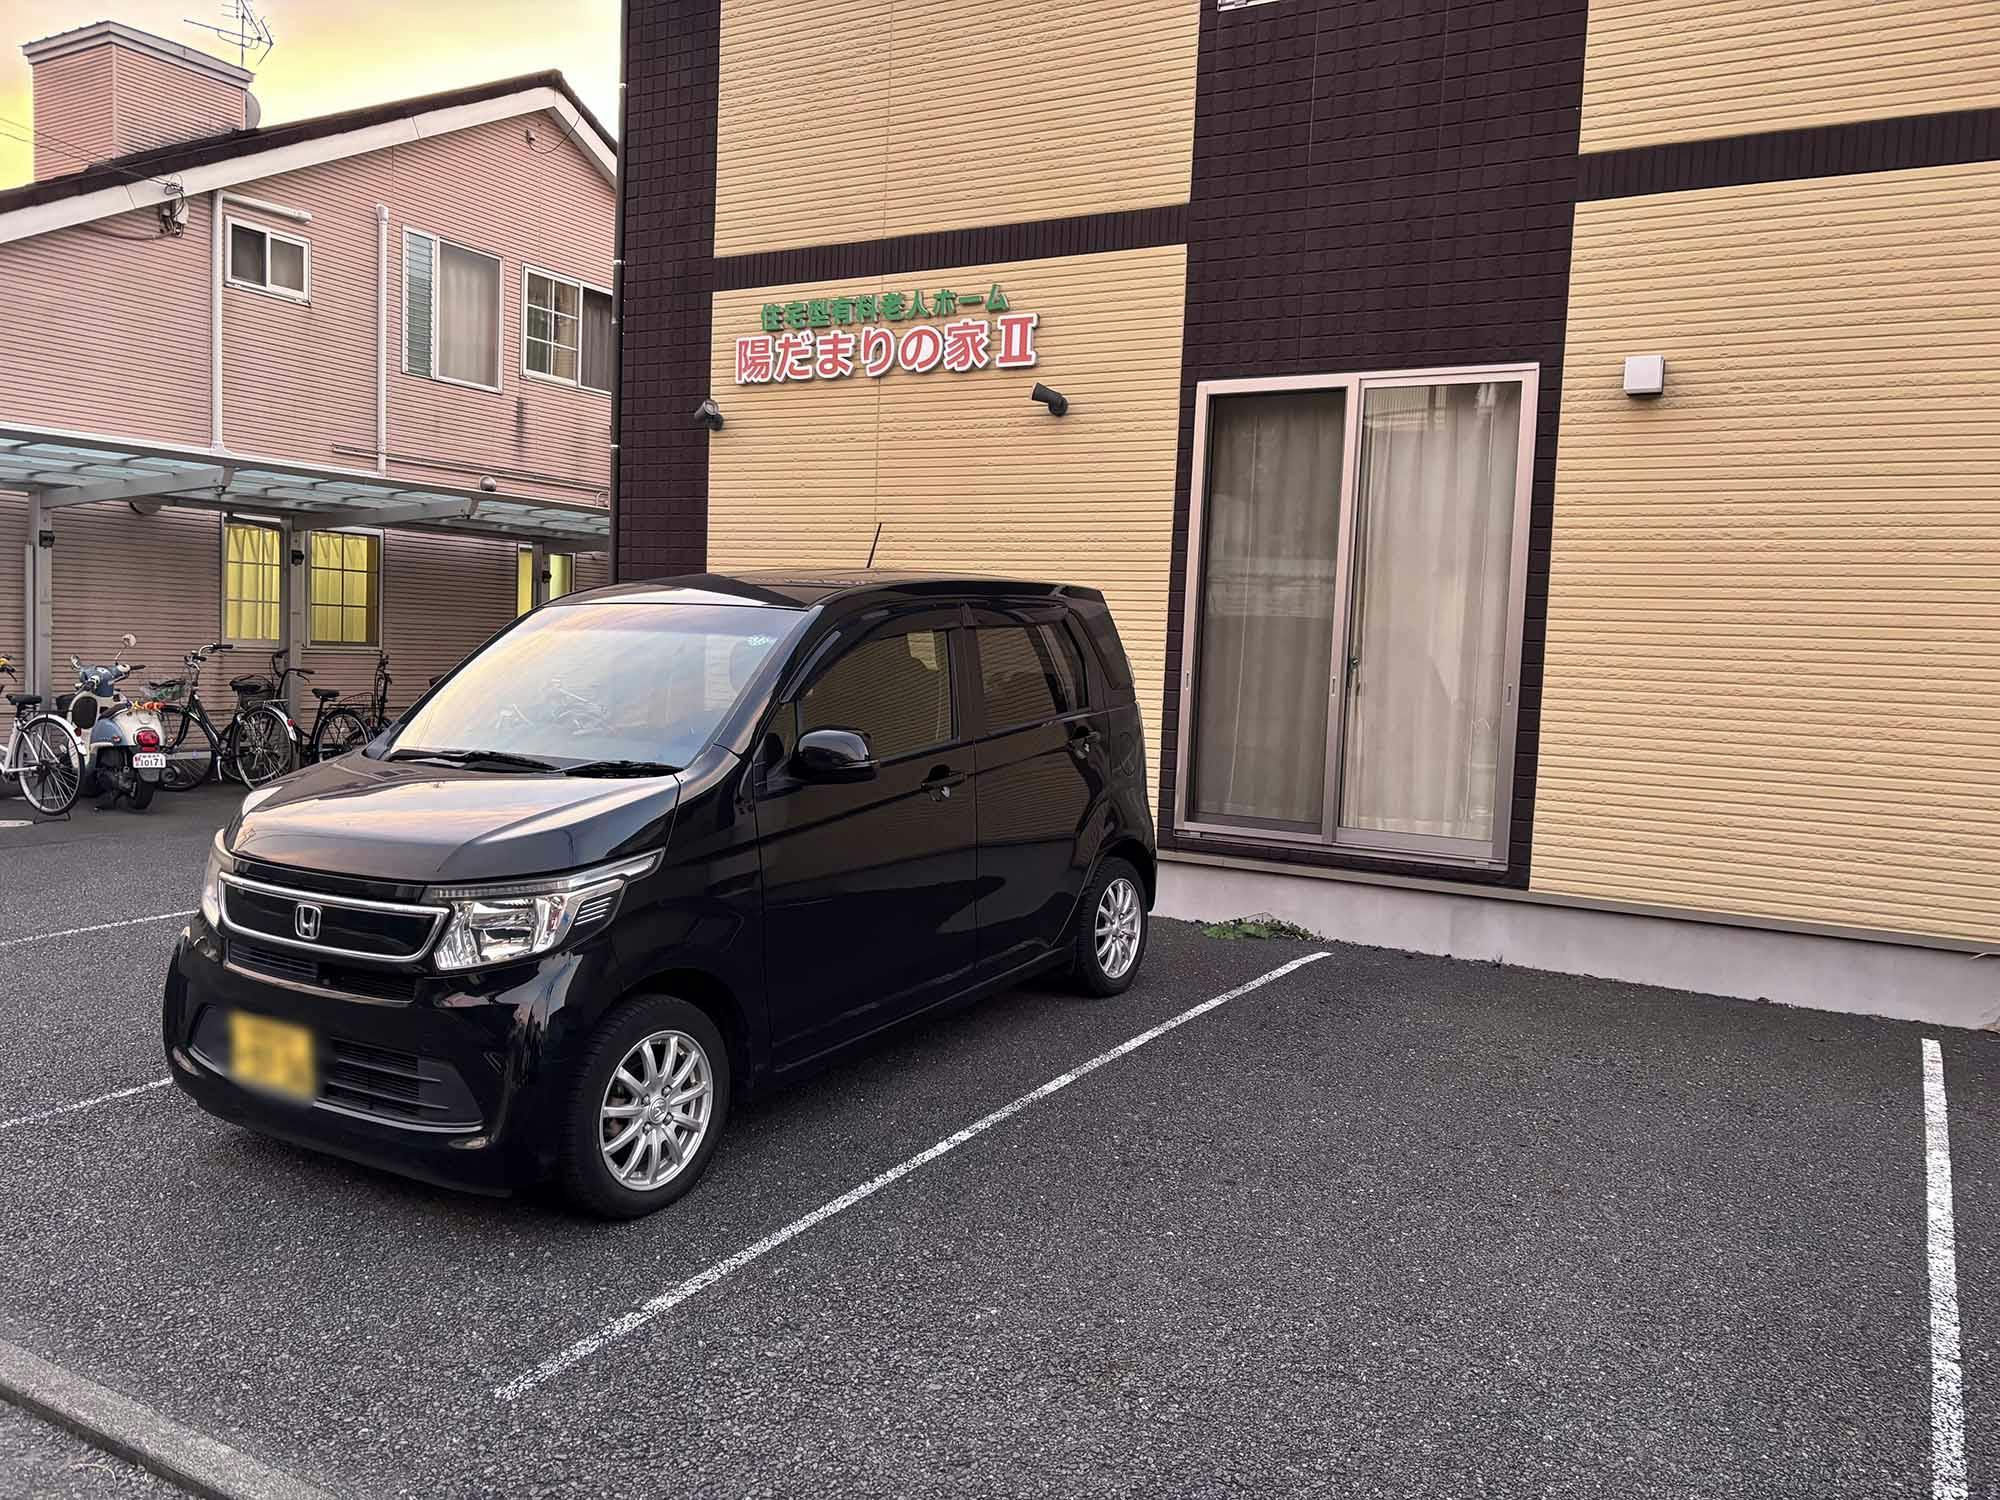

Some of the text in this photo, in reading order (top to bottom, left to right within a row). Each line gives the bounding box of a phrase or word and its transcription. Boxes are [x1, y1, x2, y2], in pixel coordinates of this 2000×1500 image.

[760, 284, 1010, 331] 住宅型有料老人ホーム
